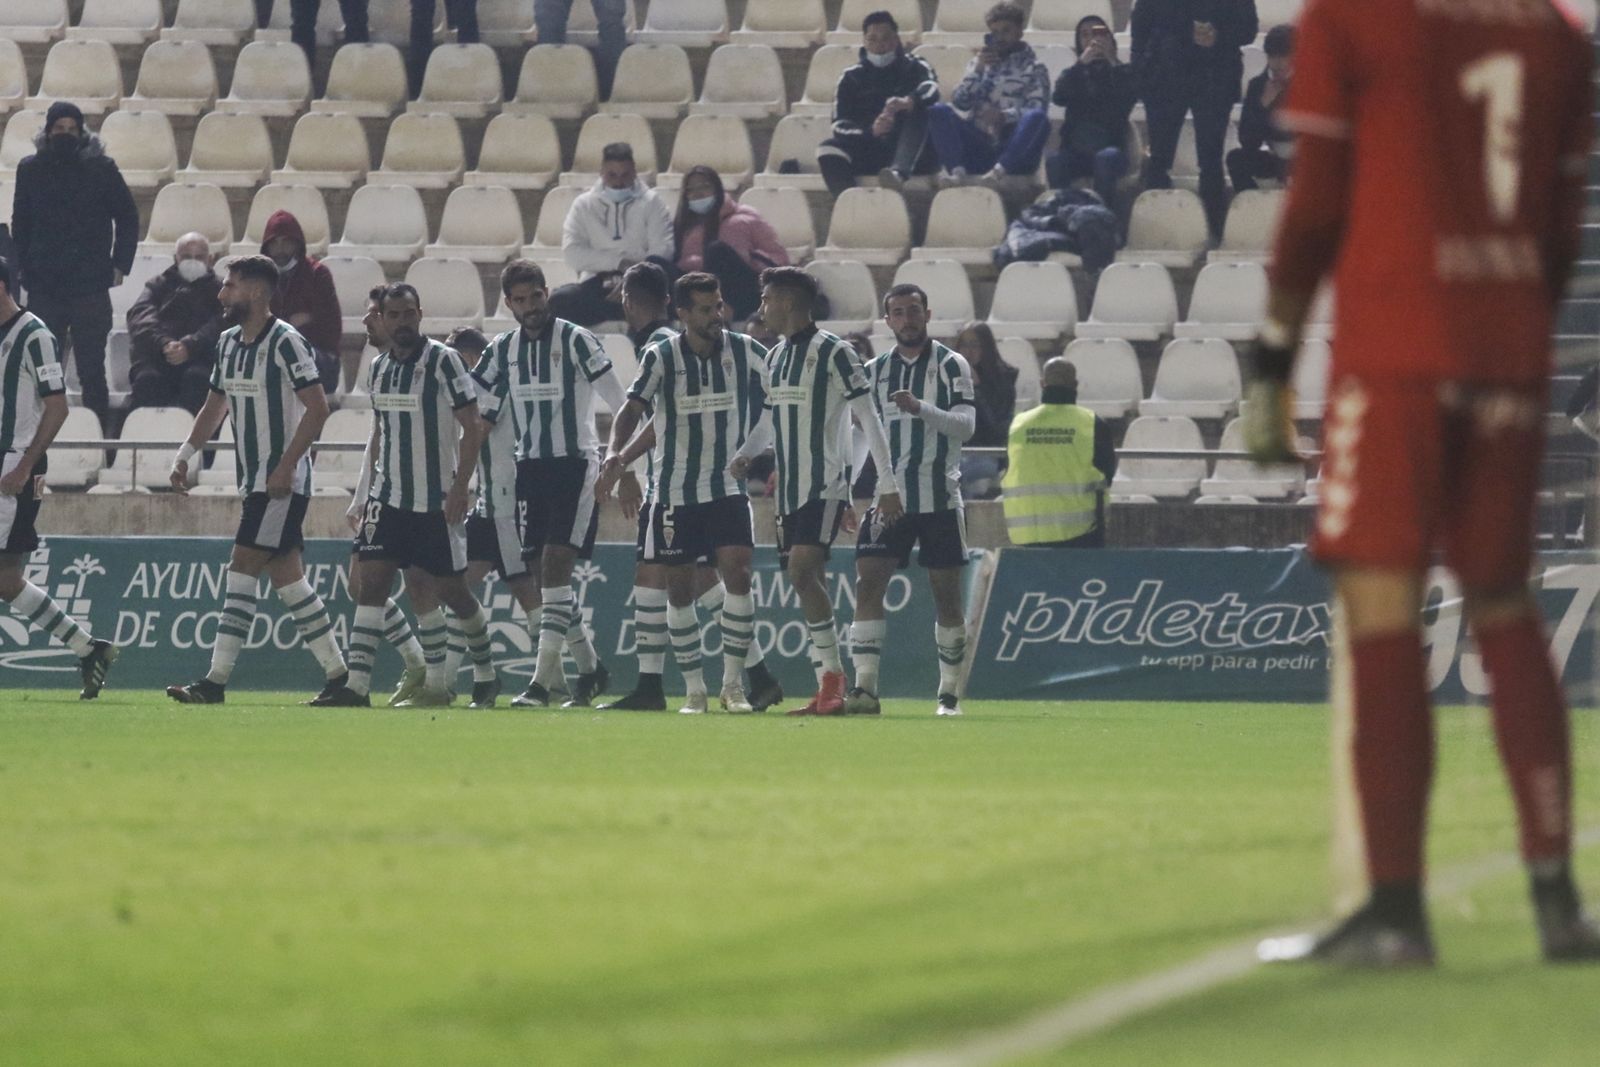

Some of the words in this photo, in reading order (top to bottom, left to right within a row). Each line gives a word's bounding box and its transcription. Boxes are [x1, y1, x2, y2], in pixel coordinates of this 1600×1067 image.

[1457, 51, 1524, 223] 1
[113, 611, 161, 648] DE
[171, 611, 350, 650] CODOA
[1166, 654, 1205, 670] app
[1211, 655, 1257, 671] para
[1264, 654, 1318, 672] pedir
